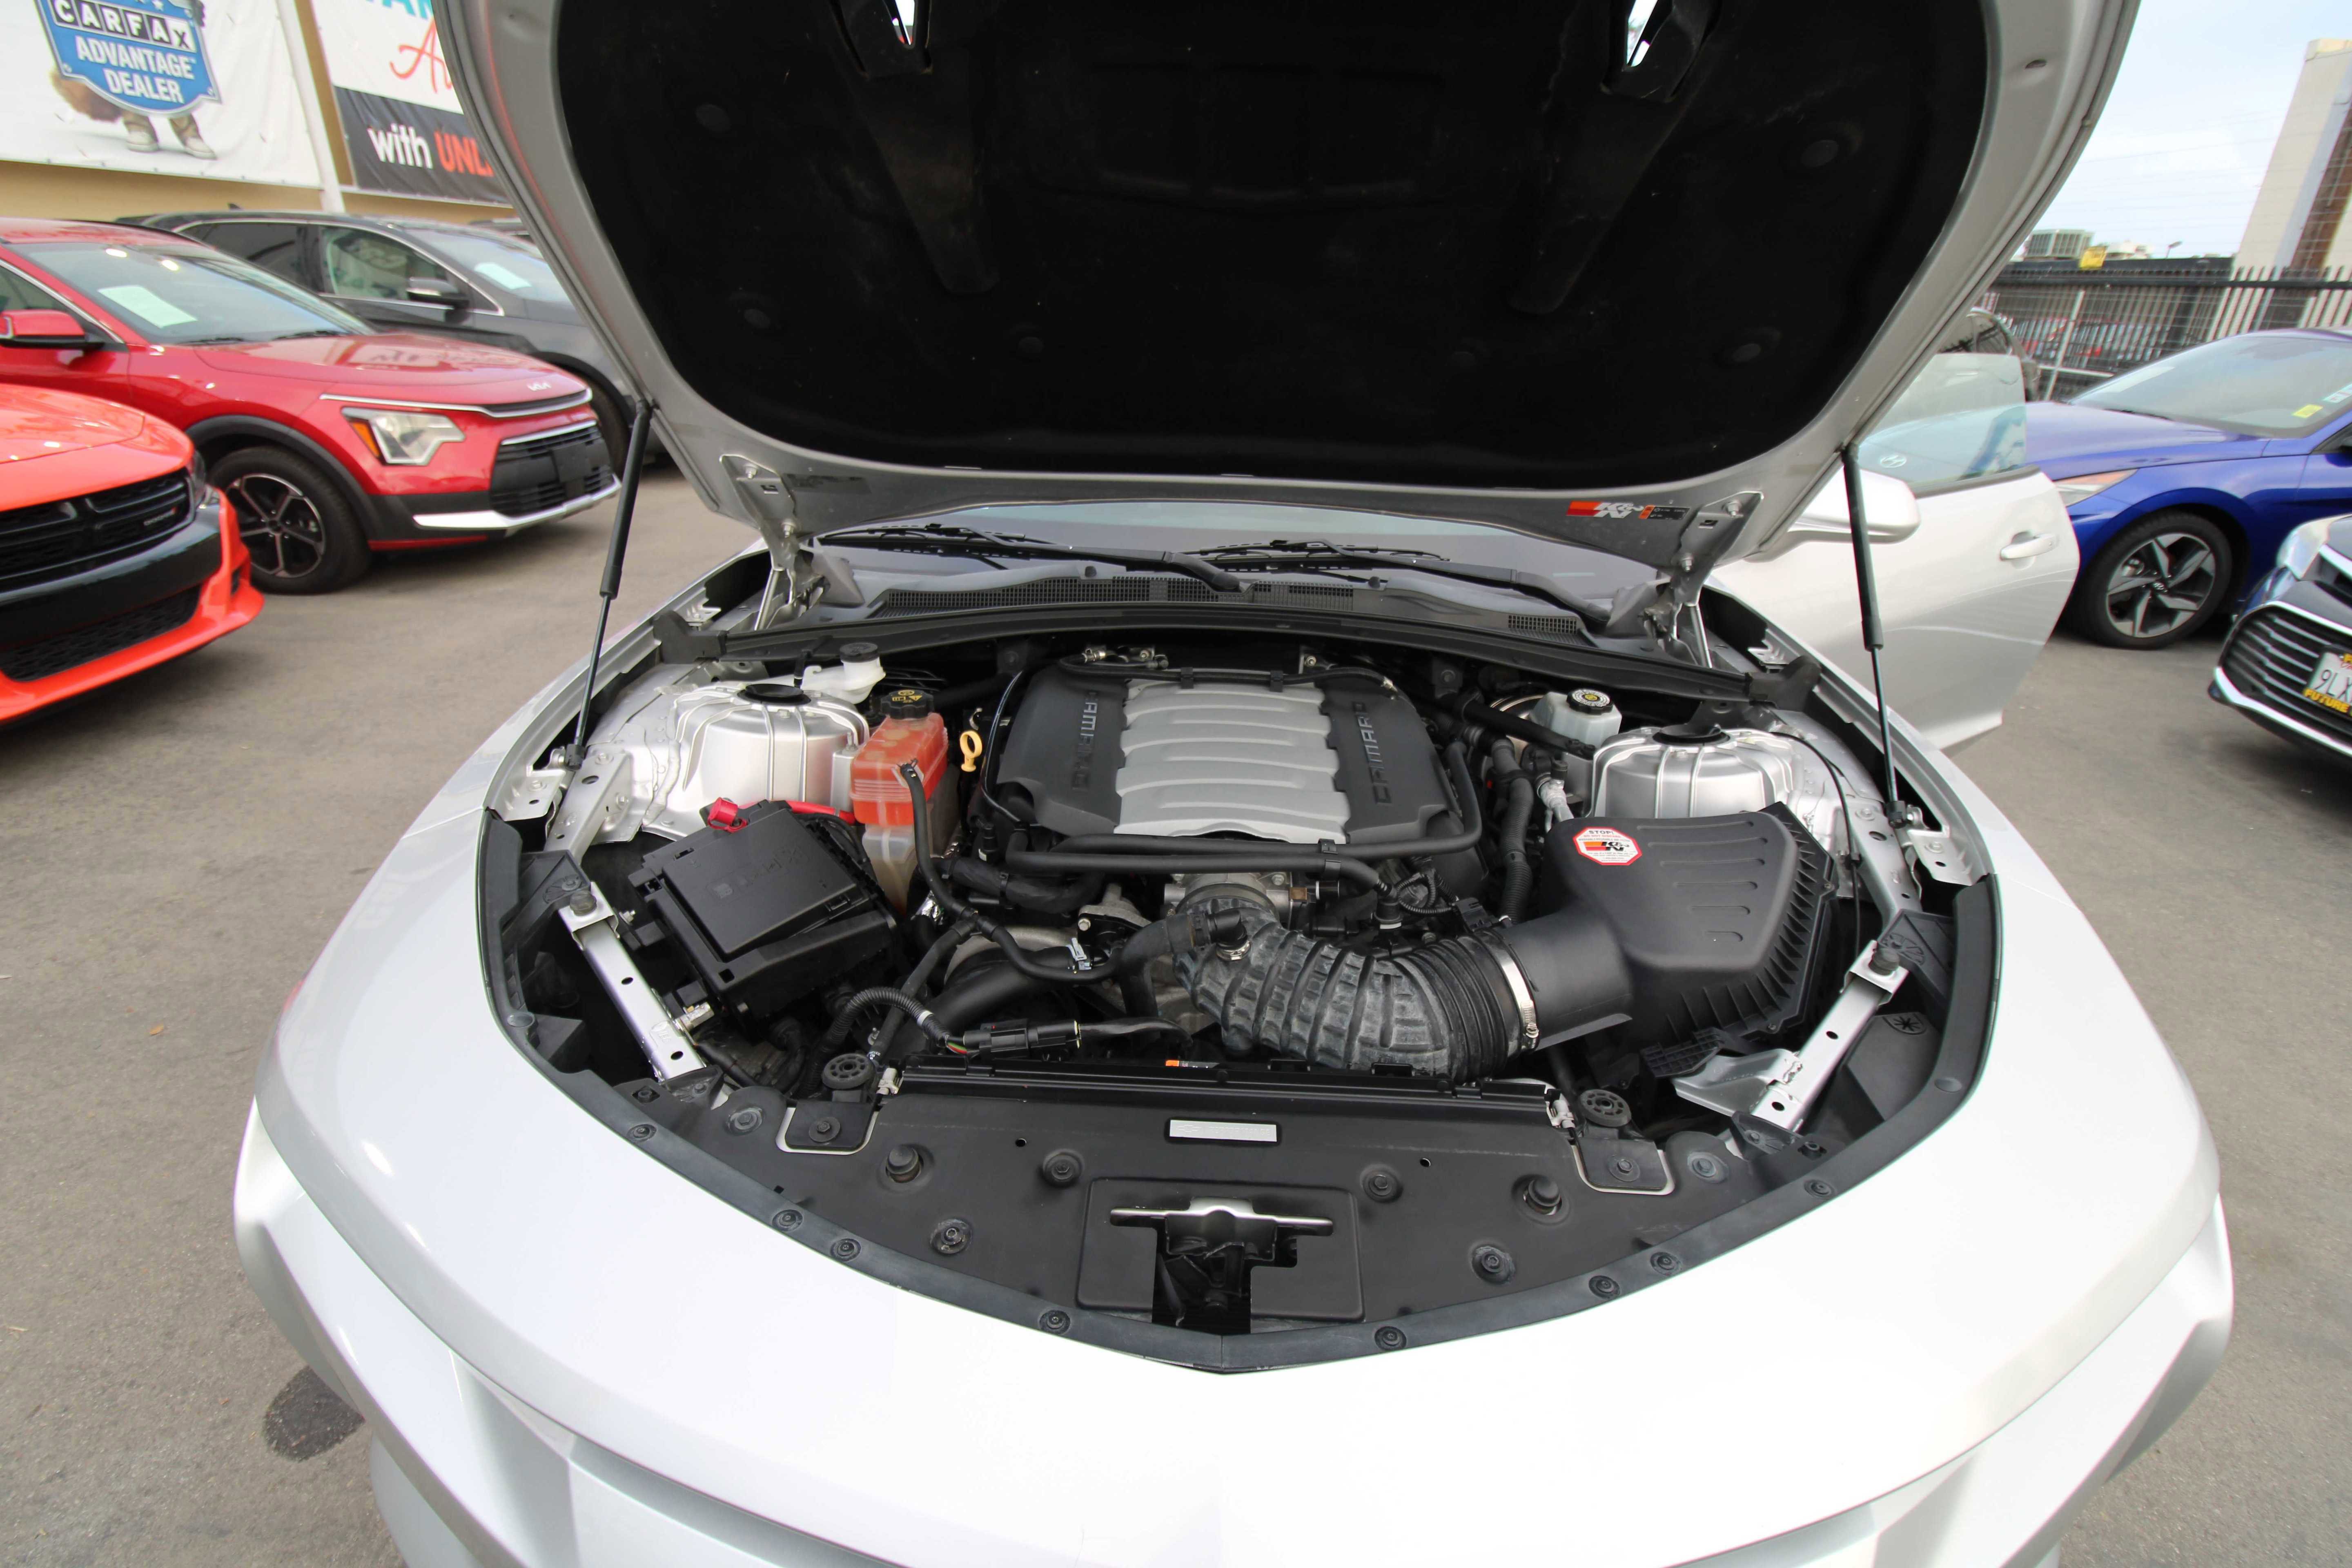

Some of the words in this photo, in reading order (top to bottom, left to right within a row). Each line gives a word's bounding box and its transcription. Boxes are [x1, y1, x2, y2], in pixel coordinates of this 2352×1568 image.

[54, 0, 190, 49] CARFAX
[75, 36, 195, 79] ADVANTAGE
[103, 68, 184, 103] DEALER
[368, 123, 433, 169] with
[434, 130, 494, 177] UNL
[2304, 688, 2350, 713] FUTURE
[2314, 669, 2352, 702] 9LX
